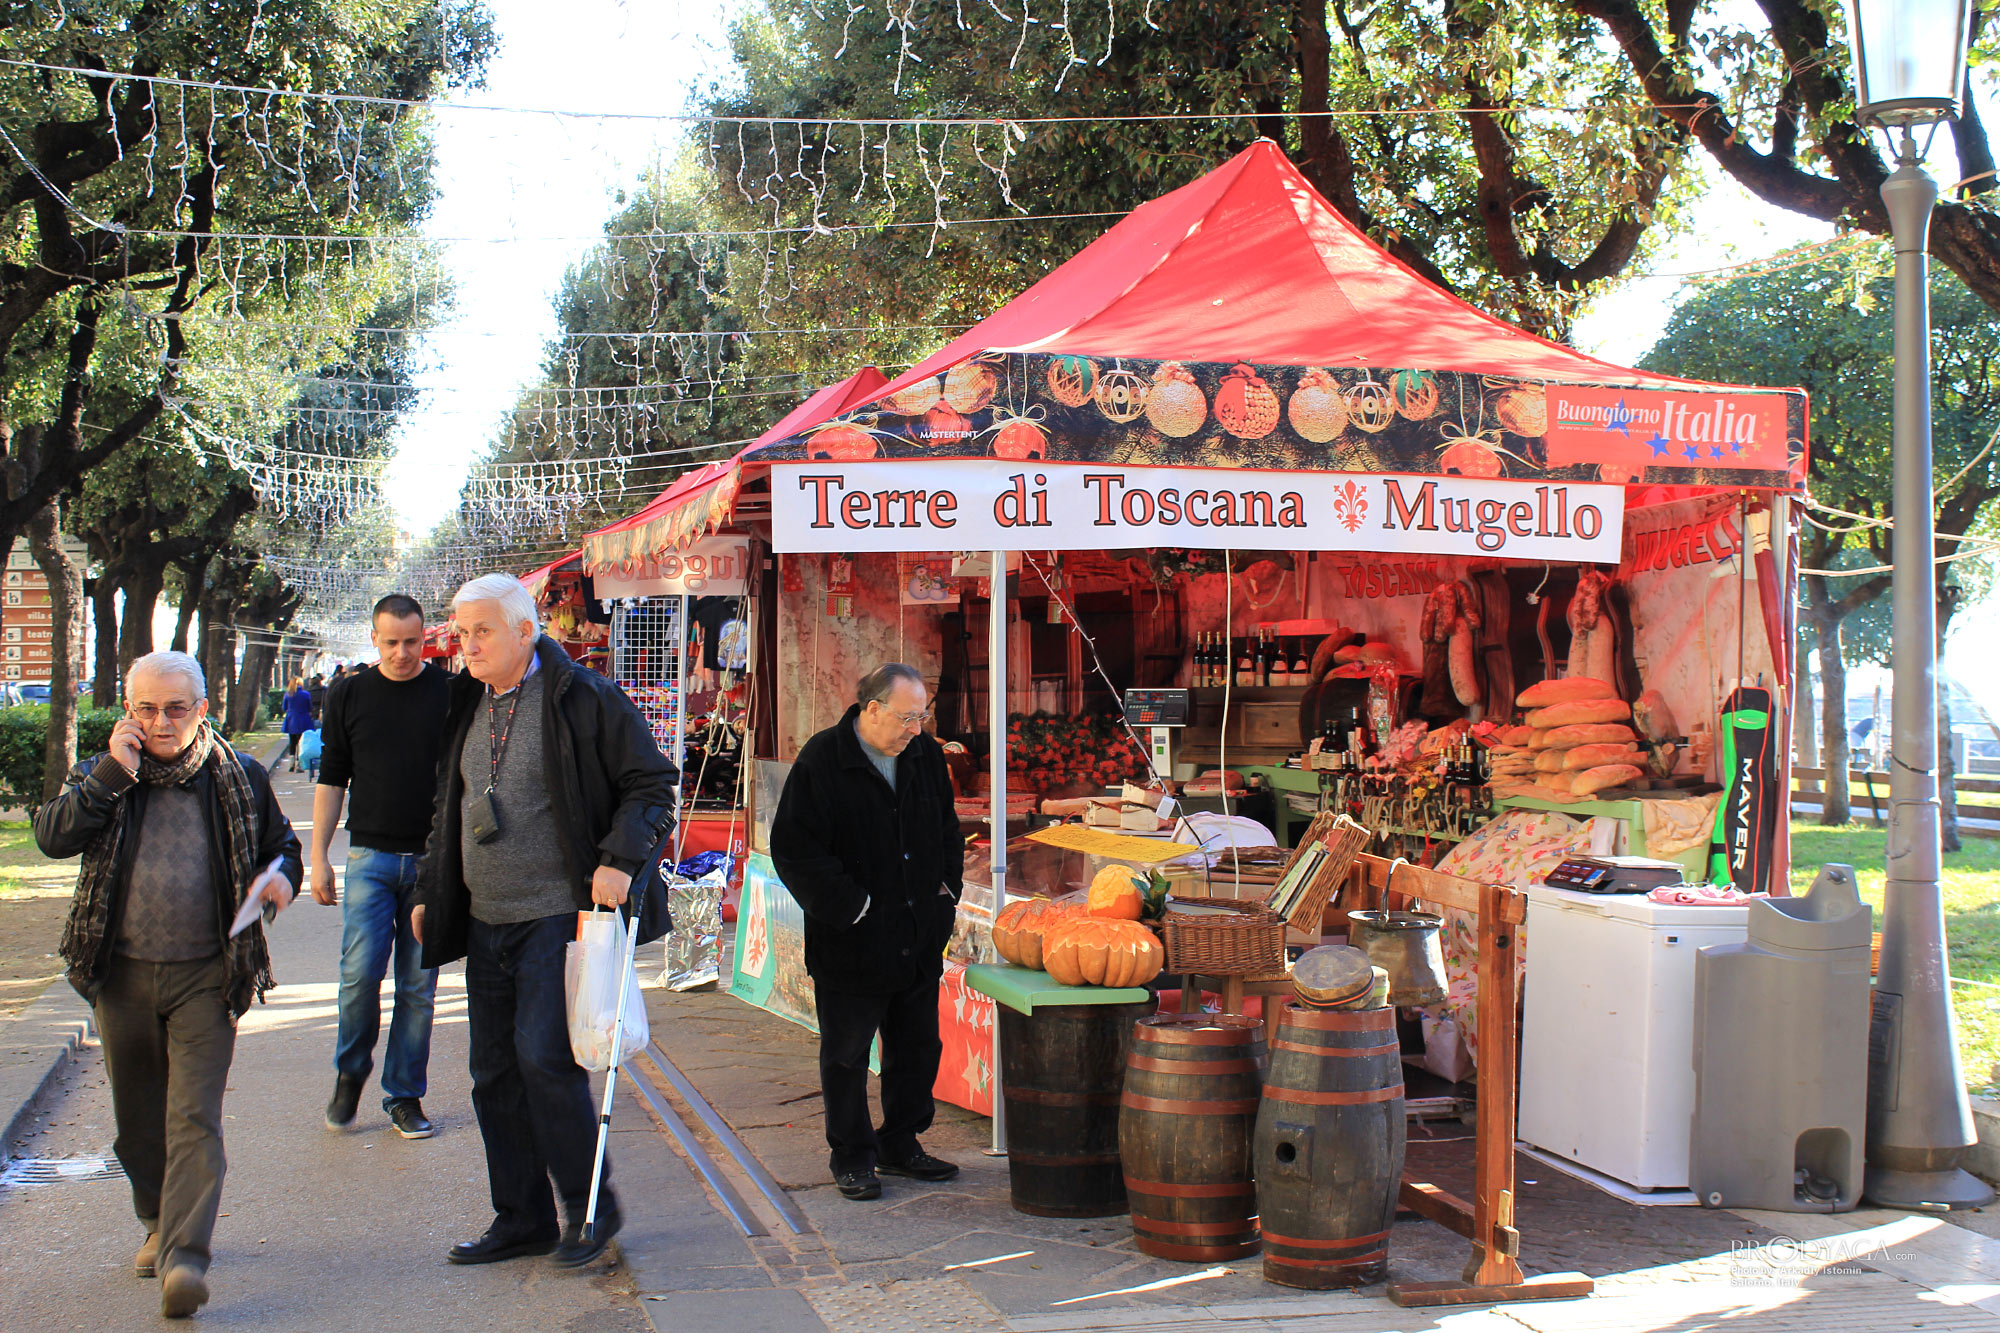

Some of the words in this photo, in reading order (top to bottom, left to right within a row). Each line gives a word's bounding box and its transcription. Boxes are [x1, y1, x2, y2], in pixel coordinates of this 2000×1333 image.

[1557, 399, 1660, 427] Buongiorno
[1661, 399, 1756, 443] Italia
[920, 430, 979, 439] MASTERTENT
[799, 474, 958, 529] Terre
[994, 473, 1053, 527] di
[1084, 474, 1307, 528] Toscana
[1382, 478, 1602, 552] Mugello
[27, 611, 46, 620] villa
[26, 667, 52, 676] castell
[1732, 758, 1753, 869] MAVER
